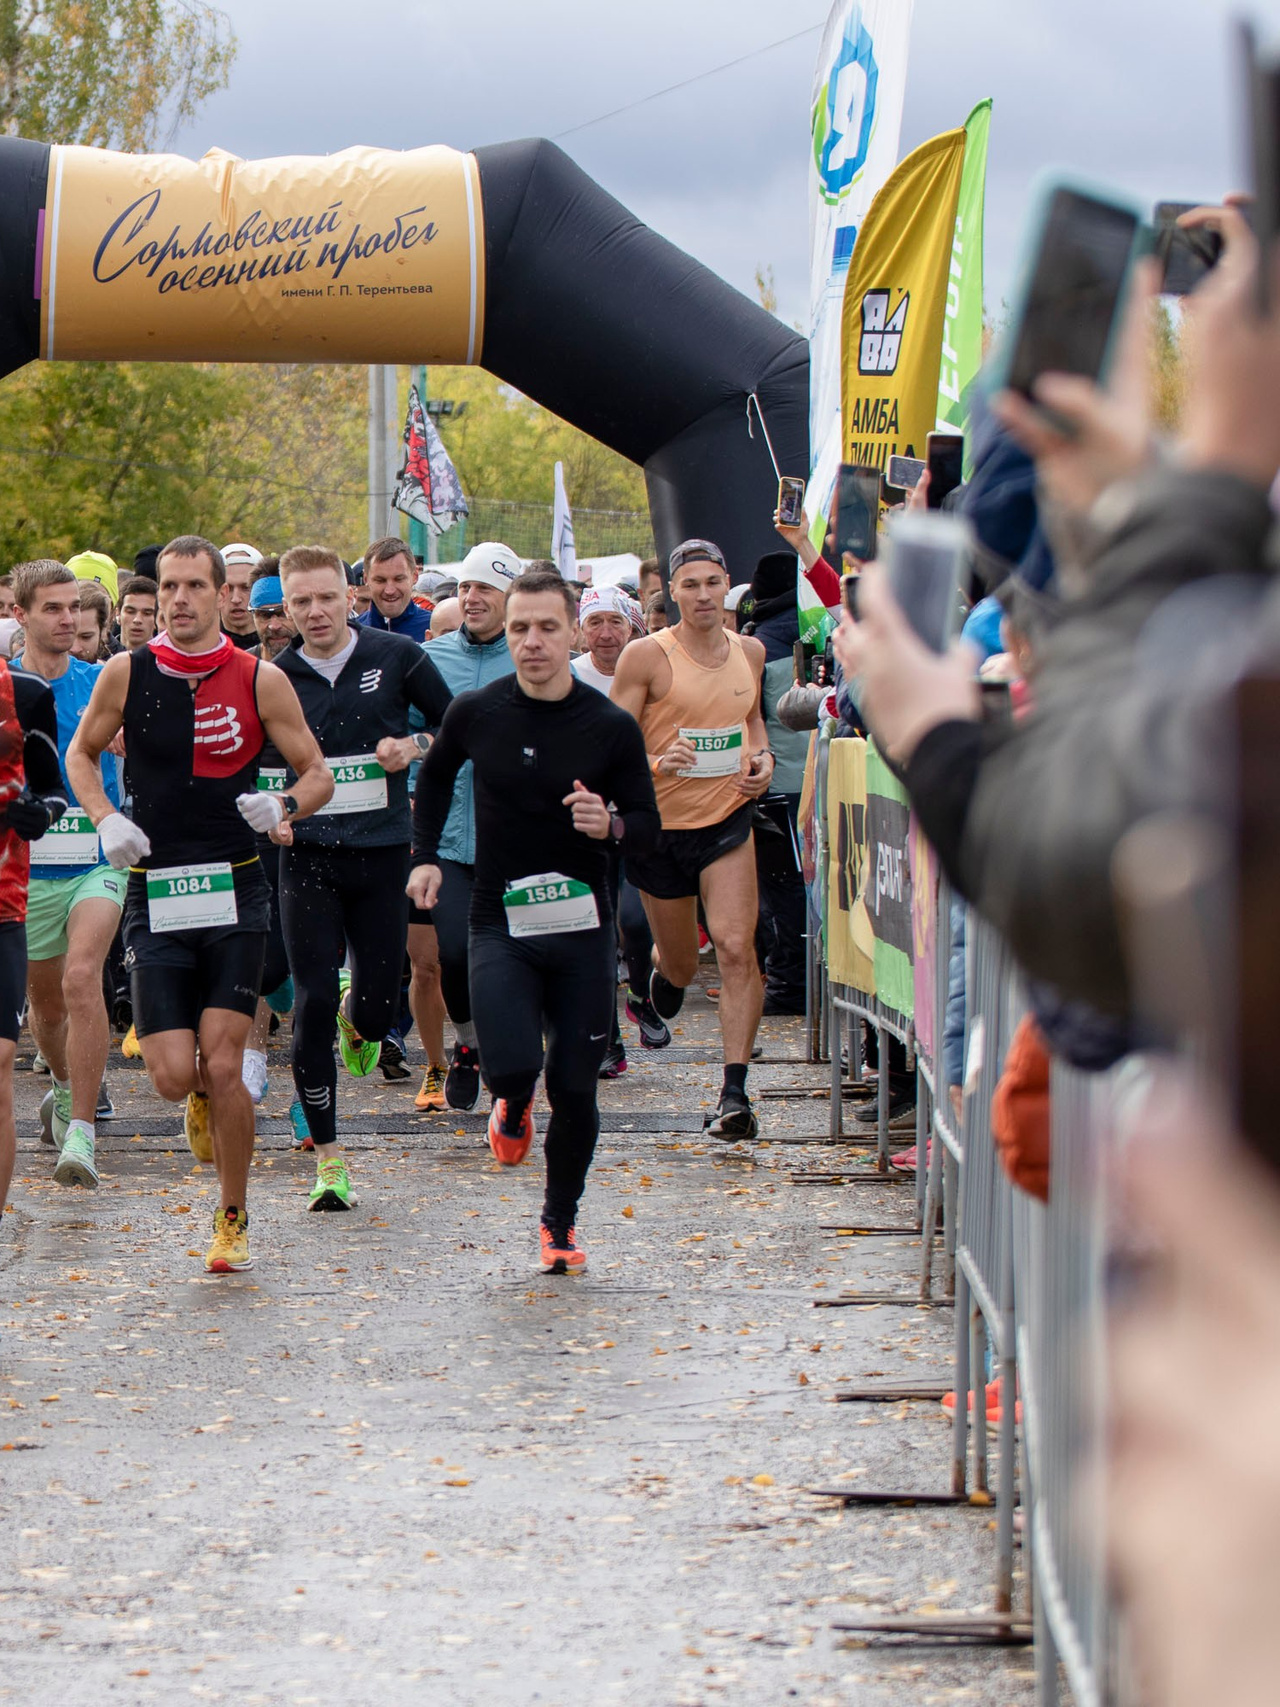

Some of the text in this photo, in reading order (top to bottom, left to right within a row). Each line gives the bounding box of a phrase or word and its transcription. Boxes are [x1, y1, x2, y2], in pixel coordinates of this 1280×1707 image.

[93, 188, 343, 283] Сормовский
[158, 205, 439, 294] осенний пробег
[281, 284, 433, 298] имени Г. П. Терентьева
[851, 397, 899, 435] АМБА
[696, 737, 730, 751] 1507
[268, 777, 286, 790] 14
[46, 818, 80, 832] 484
[168, 876, 212, 895] 1084
[525, 883, 570, 904] 1584
